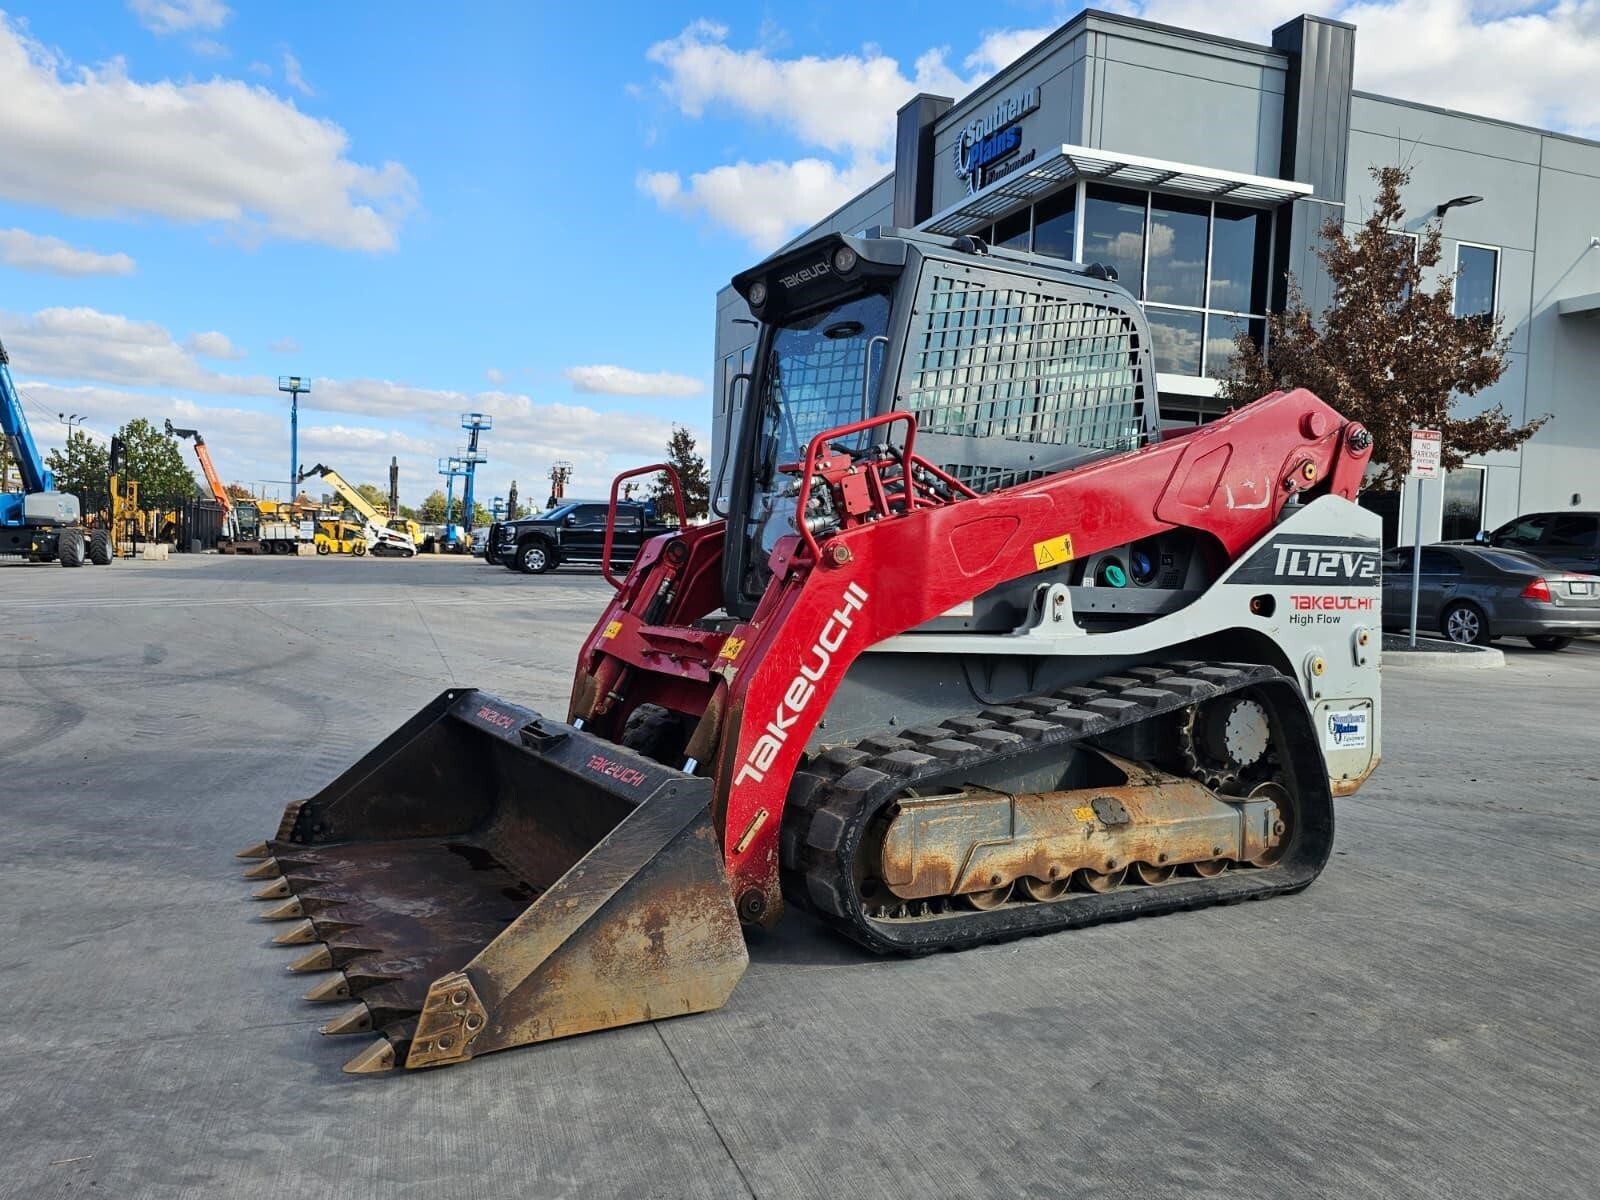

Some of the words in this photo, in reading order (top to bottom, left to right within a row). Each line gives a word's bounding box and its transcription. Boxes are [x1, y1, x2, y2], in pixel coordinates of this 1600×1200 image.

[966, 87, 1038, 146] Southern
[1289, 614, 1314, 626] High
[1317, 614, 1341, 624] Flow
[734, 581, 869, 787] TAKEUCHI
